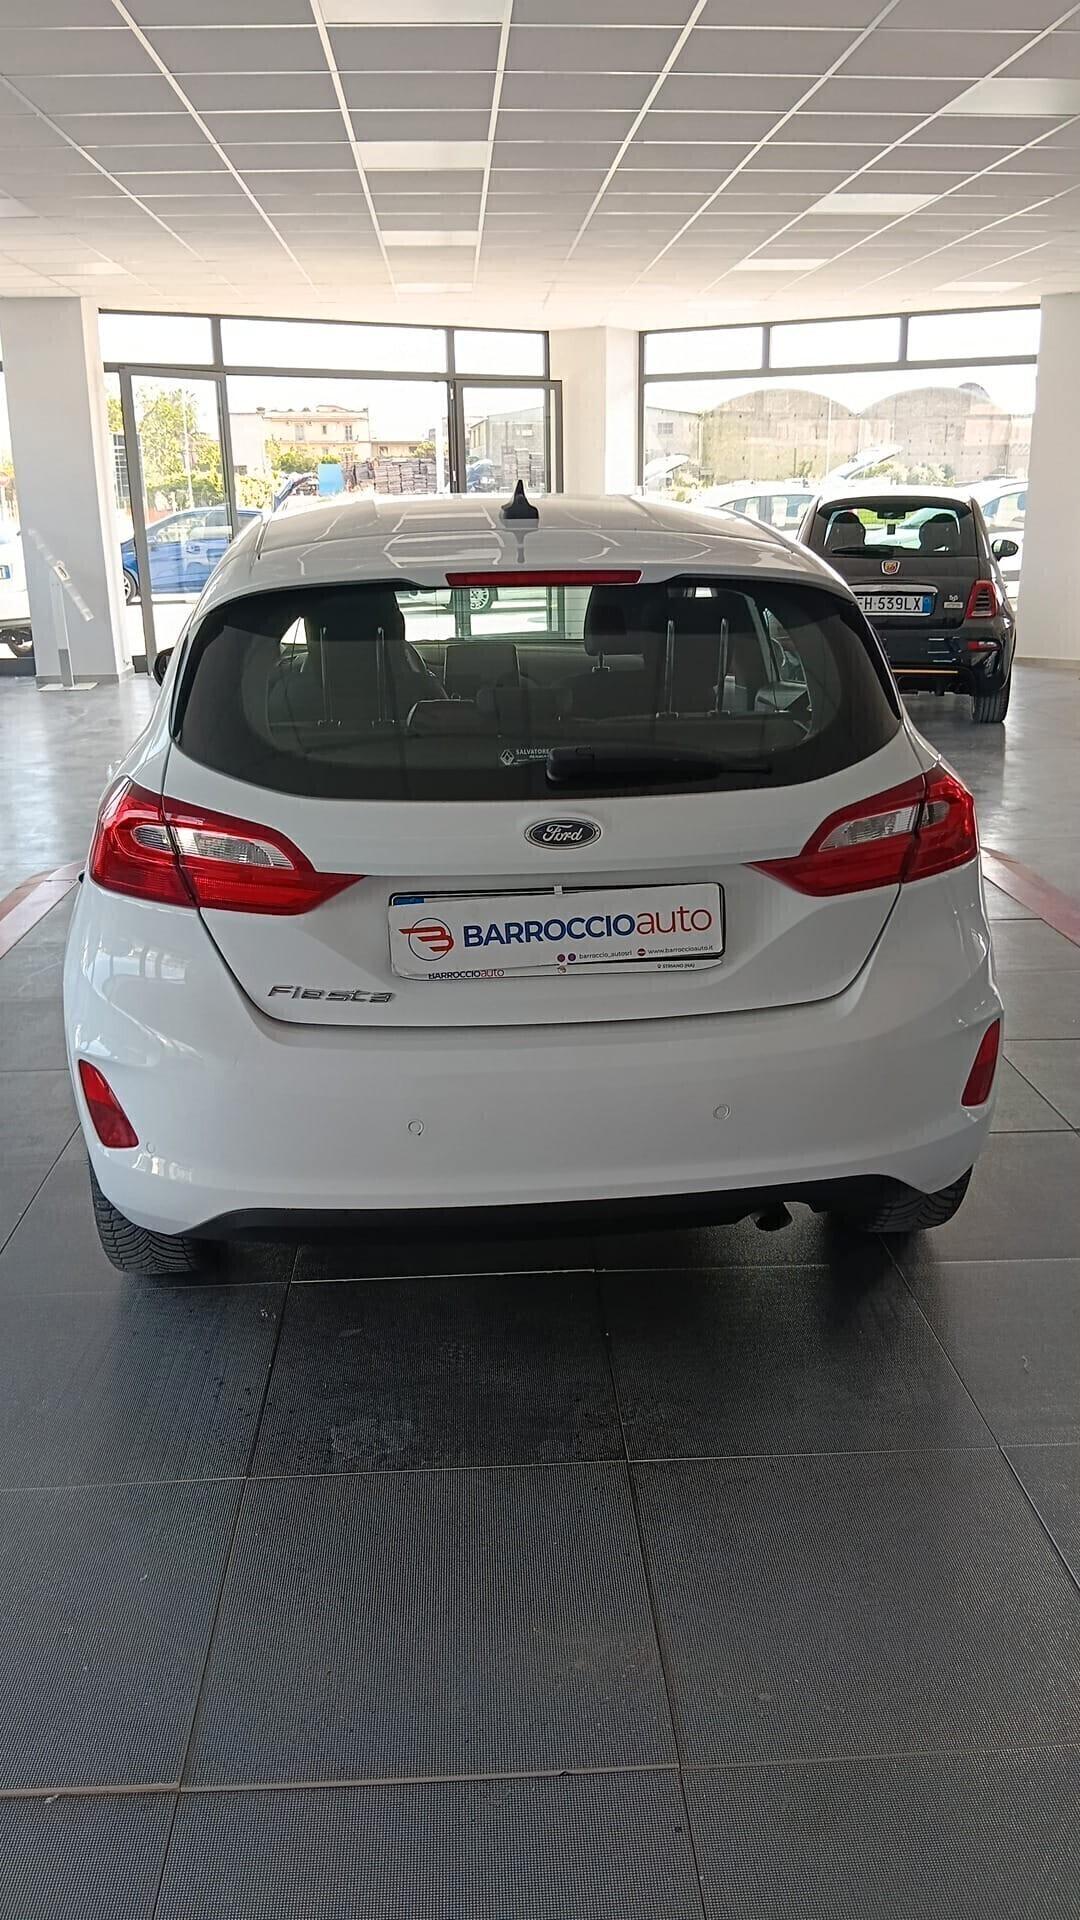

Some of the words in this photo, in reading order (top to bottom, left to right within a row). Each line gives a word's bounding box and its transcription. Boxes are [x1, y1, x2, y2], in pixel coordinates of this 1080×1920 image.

[878, 596, 921, 610] 539LX
[542, 824, 584, 842] Ford
[463, 906, 713, 948] BARROCCIOauto
[648, 945, 714, 955] www.barroccioauto.it
